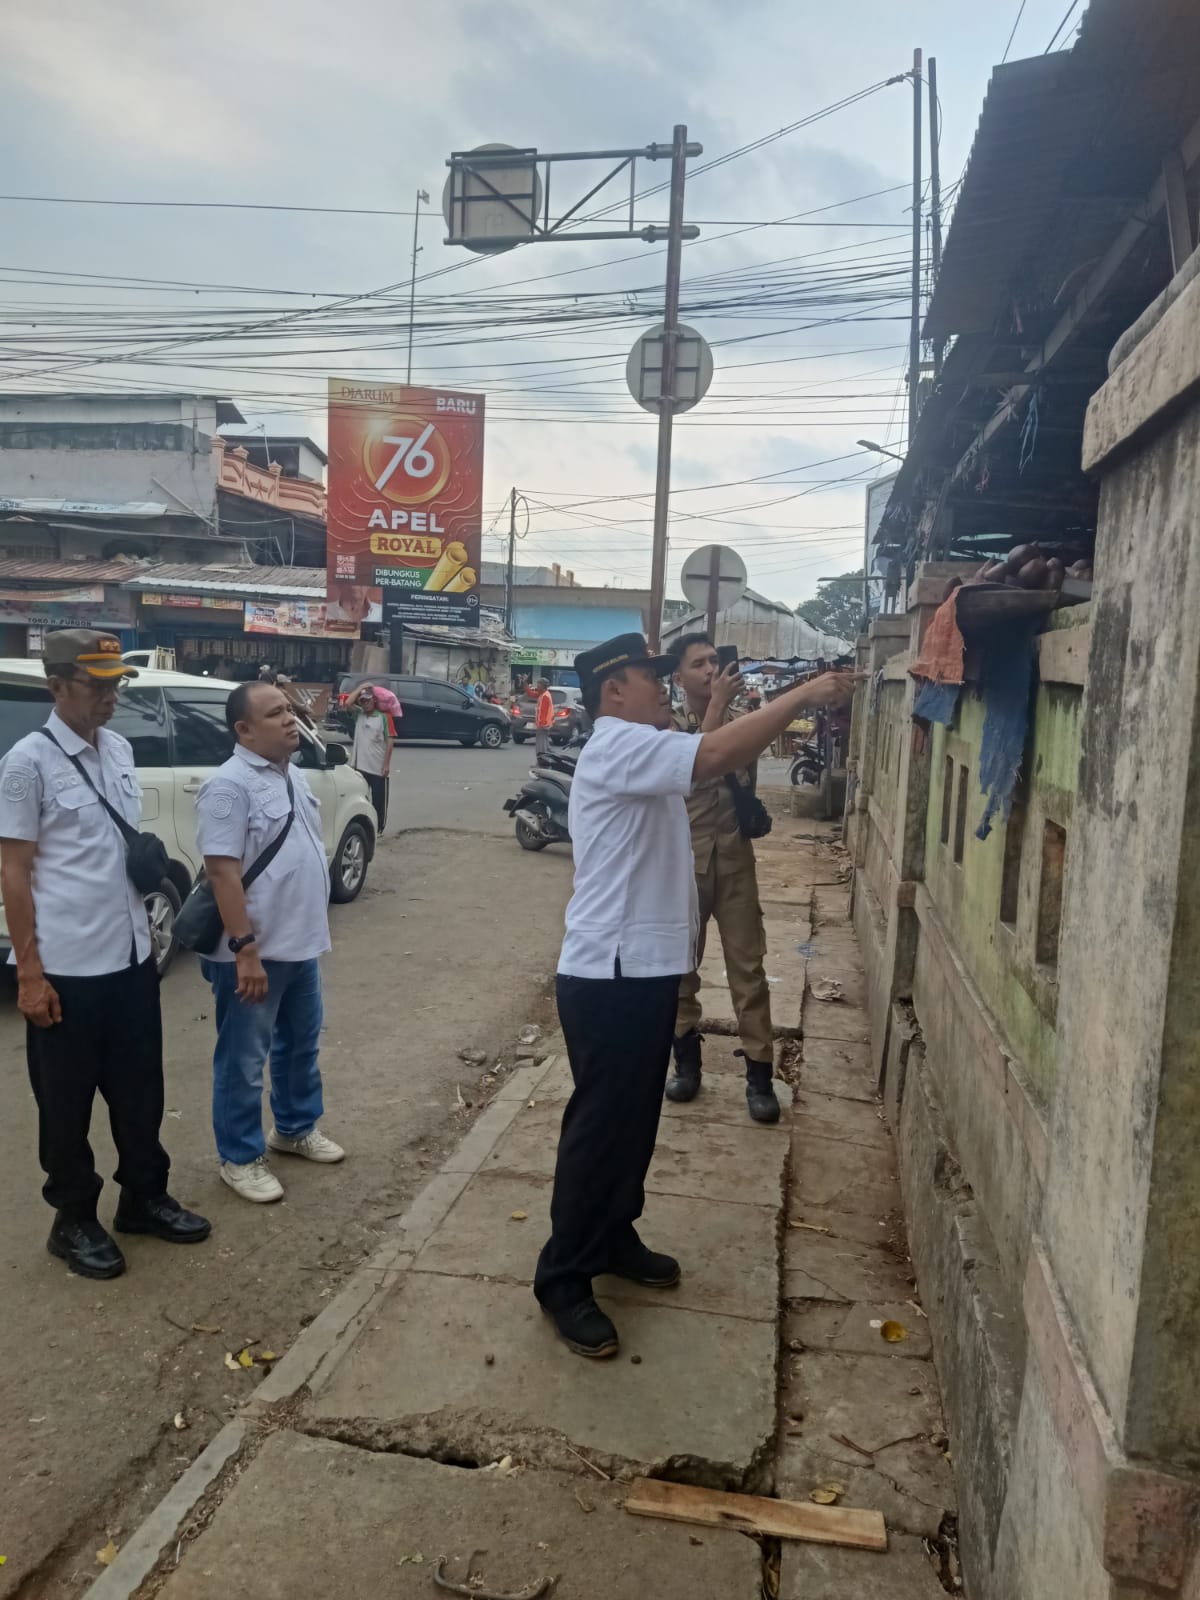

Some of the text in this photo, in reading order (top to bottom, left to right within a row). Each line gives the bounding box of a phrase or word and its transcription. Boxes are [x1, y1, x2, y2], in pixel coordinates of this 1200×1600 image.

[341, 386, 394, 403] DJARUM
[436, 397, 477, 415] BARU
[374, 423, 436, 493] 76
[367, 509, 445, 533] APEL
[377, 536, 437, 555] ROYAL
[375, 568, 420, 579] DIBUNGKUS
[375, 577, 422, 588] PER-BATANG
